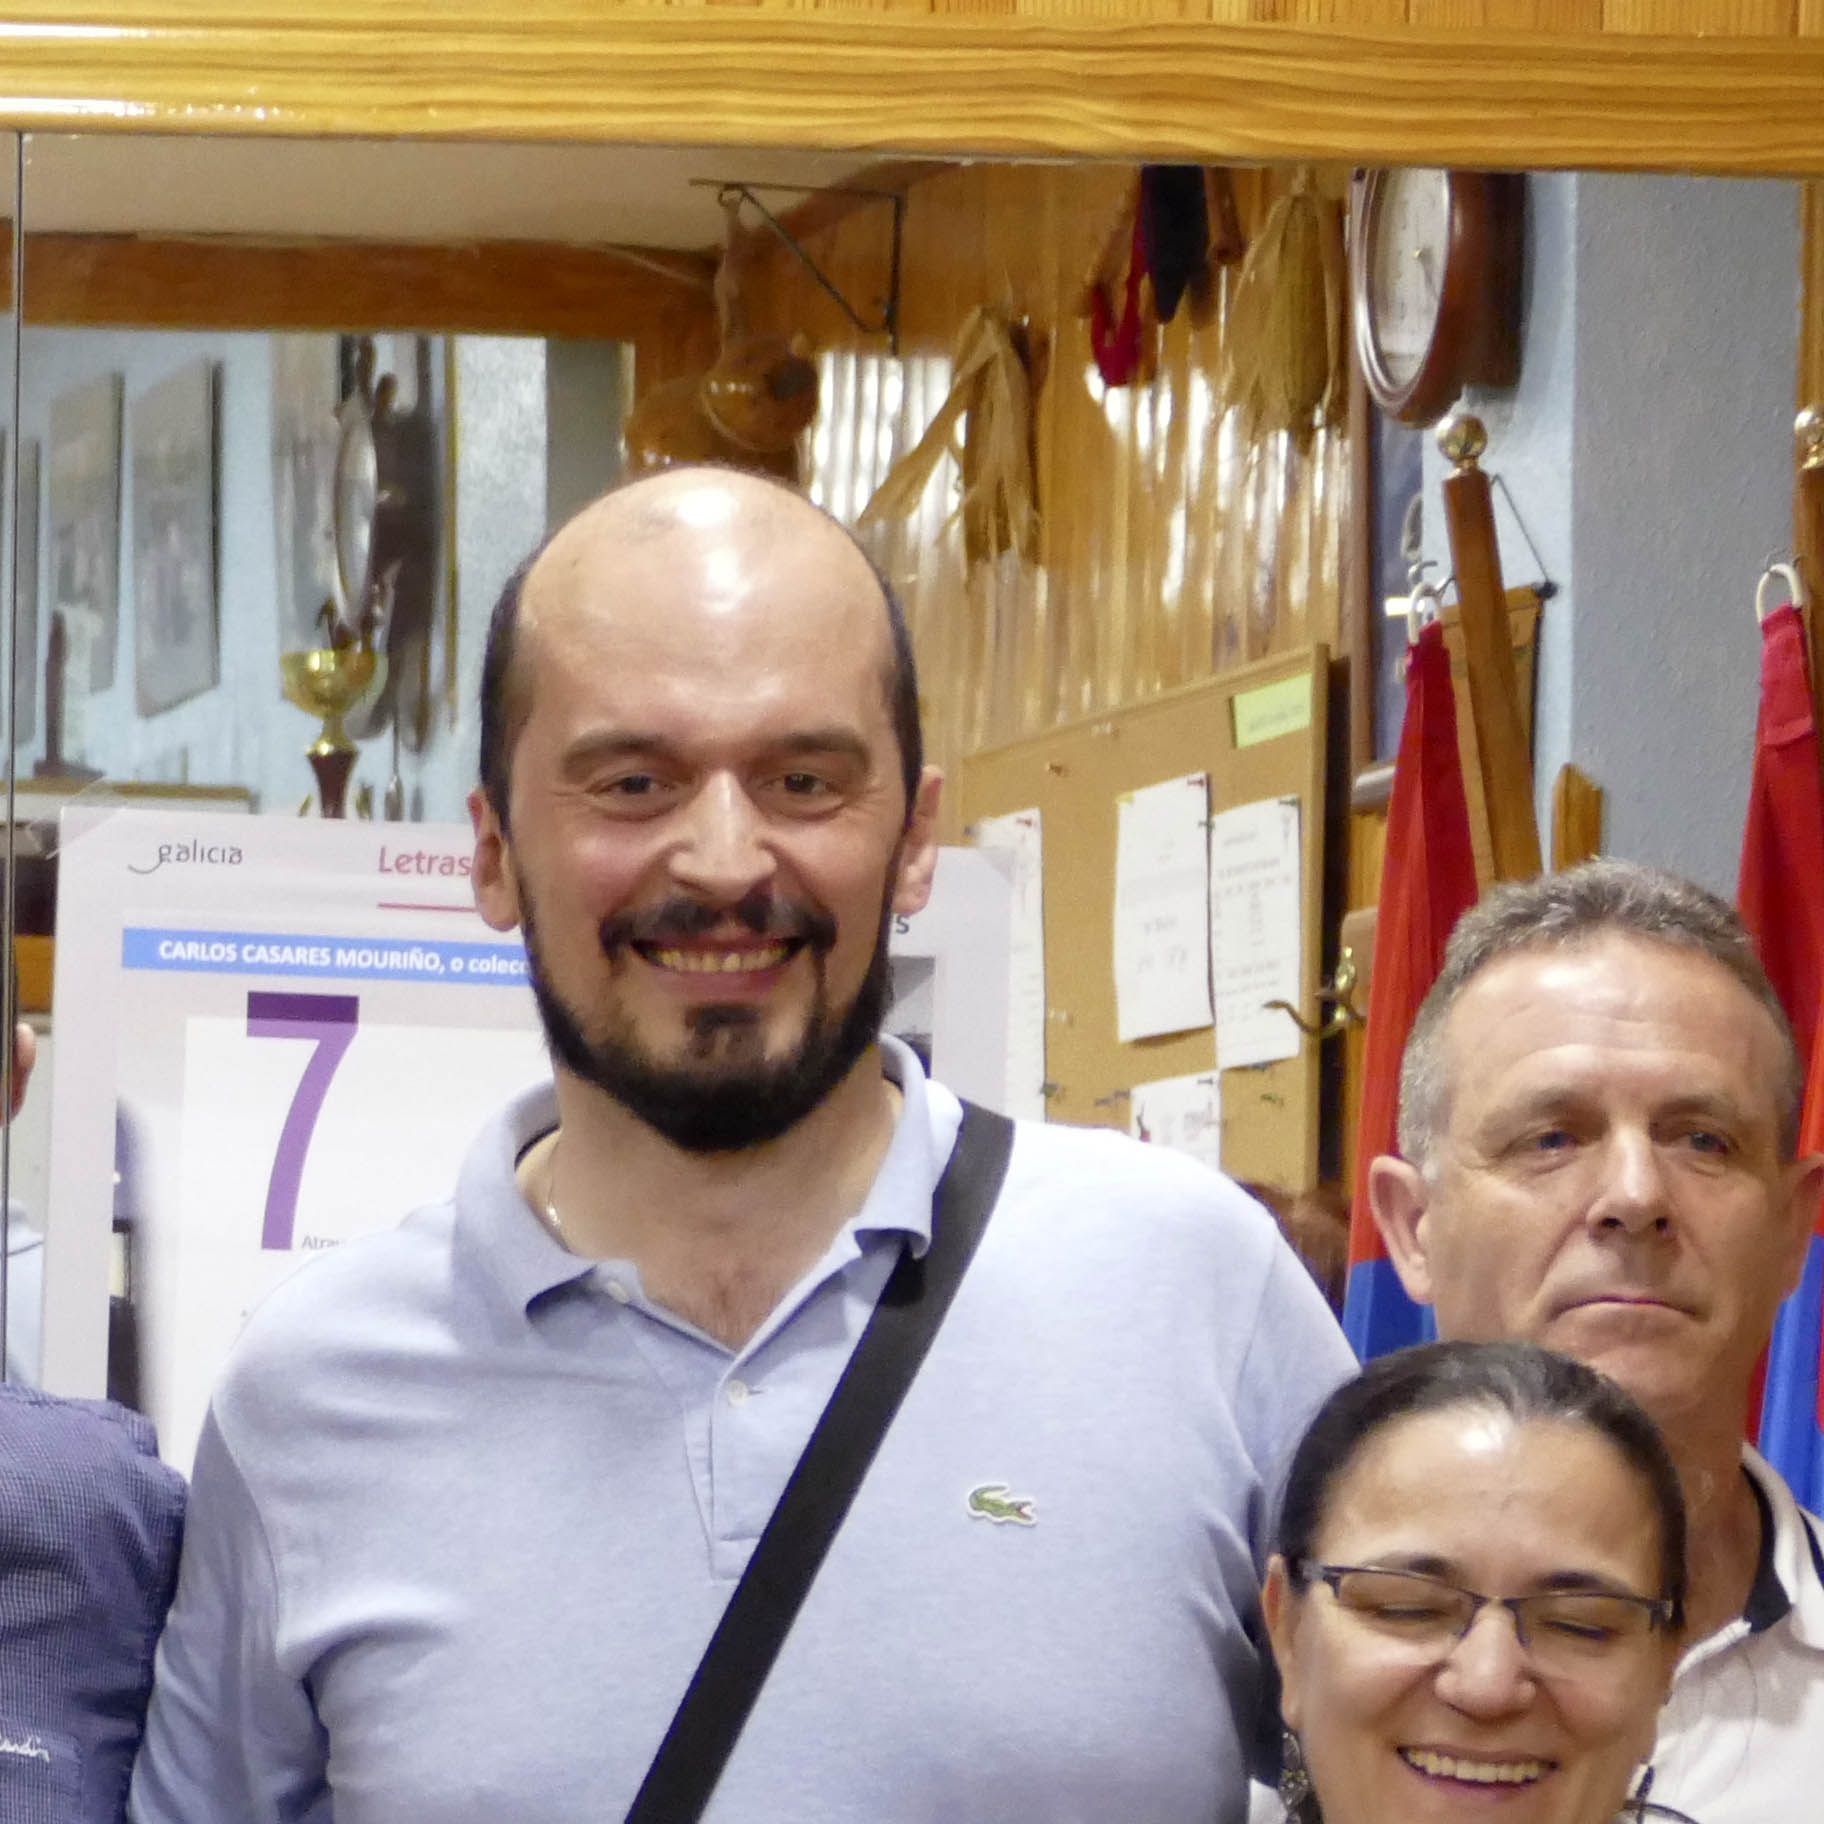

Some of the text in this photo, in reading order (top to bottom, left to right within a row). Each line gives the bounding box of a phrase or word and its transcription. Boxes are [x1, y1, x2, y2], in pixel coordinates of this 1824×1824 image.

[127, 838, 243, 874] galicia
[378, 845, 472, 877] Letras
[158, 939, 237, 963] CARLOS
[242, 942, 331, 967] CASARES
[336, 945, 445, 974] MOURIÑO,
[450, 957, 464, 973] o
[246, 990, 360, 1251] 7
